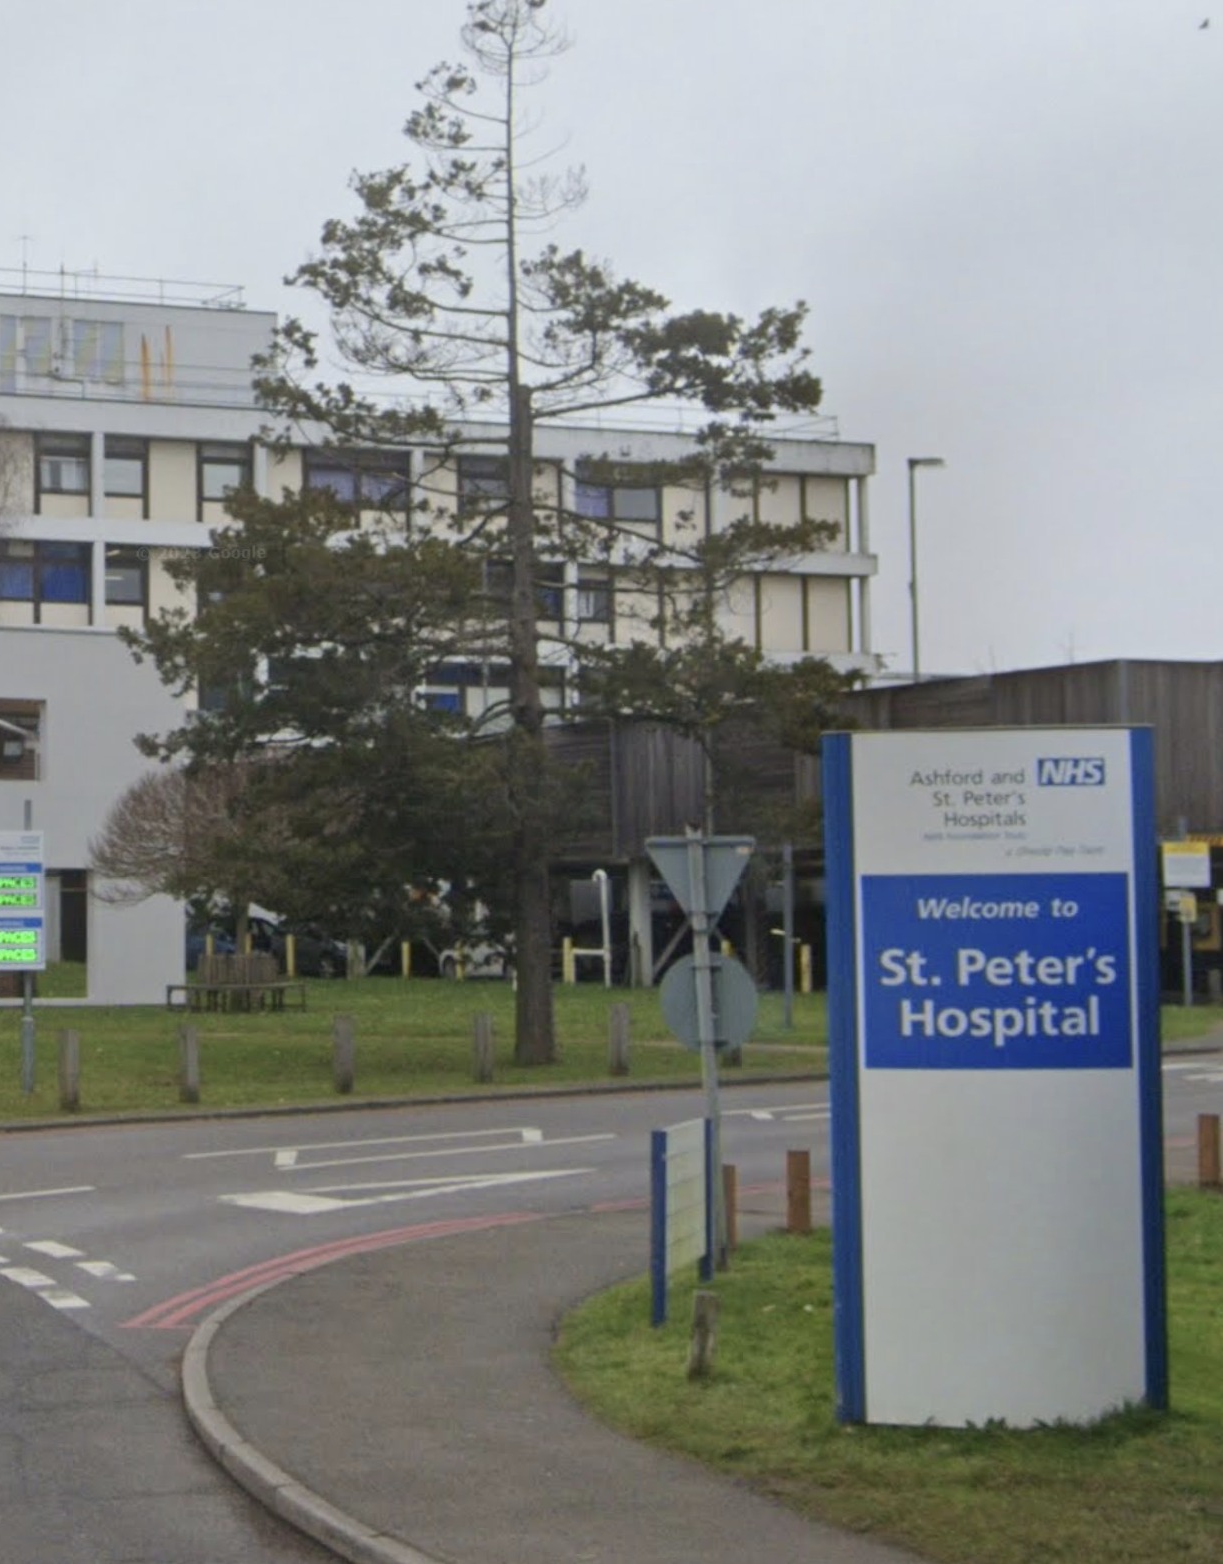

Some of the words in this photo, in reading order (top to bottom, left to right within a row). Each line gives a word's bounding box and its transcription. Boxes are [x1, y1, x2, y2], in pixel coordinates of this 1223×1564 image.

[910, 768, 982, 787] Ashford
[991, 768, 1025, 785] and
[1039, 758, 1104, 785] NHS
[964, 790, 1026, 806] Peter's
[945, 811, 1026, 829] Hospitals
[917, 896, 1039, 919] Welcome
[1051, 898, 1079, 918] to
[880, 948, 941, 986] St.
[957, 947, 1116, 986] Peter's
[900, 995, 1099, 1047] Hospital
